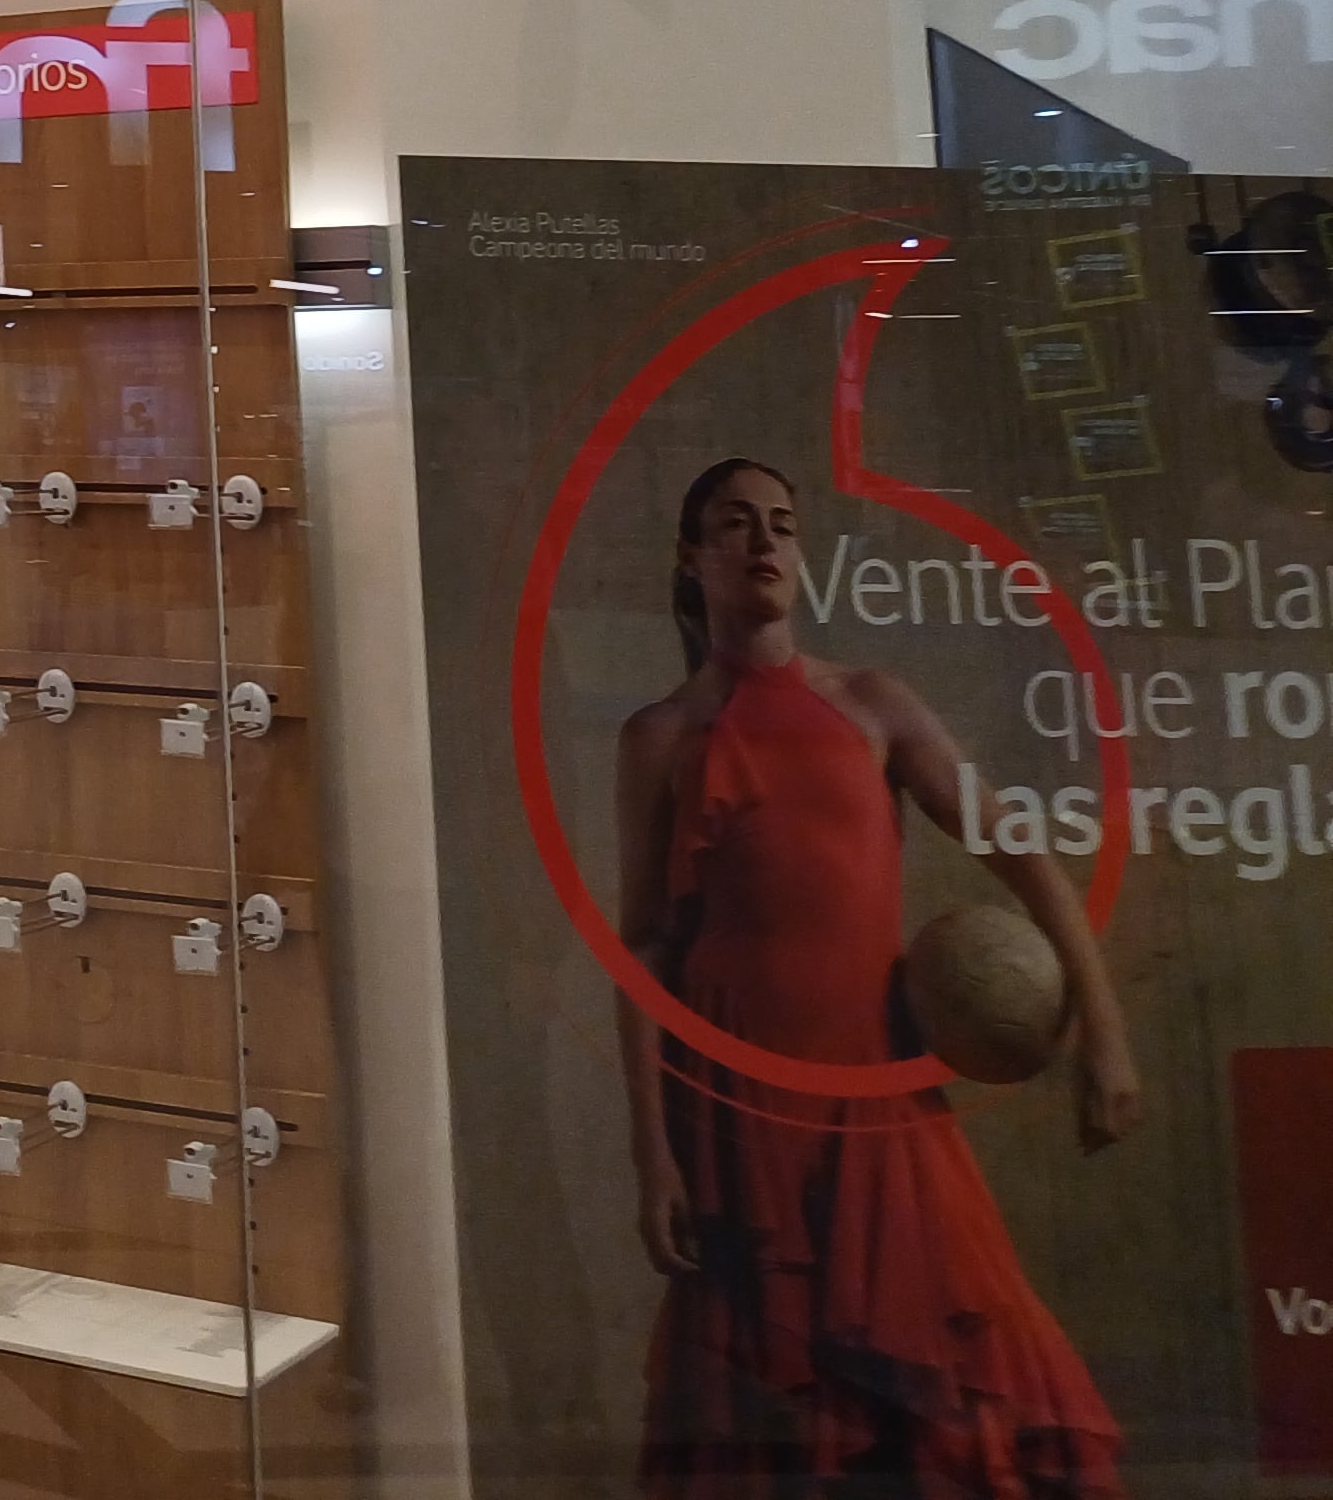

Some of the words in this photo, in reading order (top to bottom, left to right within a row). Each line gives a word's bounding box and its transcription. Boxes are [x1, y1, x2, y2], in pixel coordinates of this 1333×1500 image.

[591, 239, 623, 260] del
[629, 242, 707, 262] mundo
[797, 533, 1053, 628] Vente
[1186, 538, 1333, 630] Pla
[1023, 668, 1194, 762] que
[1222, 668, 1333, 740] ro
[957, 762, 1102, 856] las
[1127, 763, 1333, 882] regl
[1265, 1287, 1333, 1336] Vo
